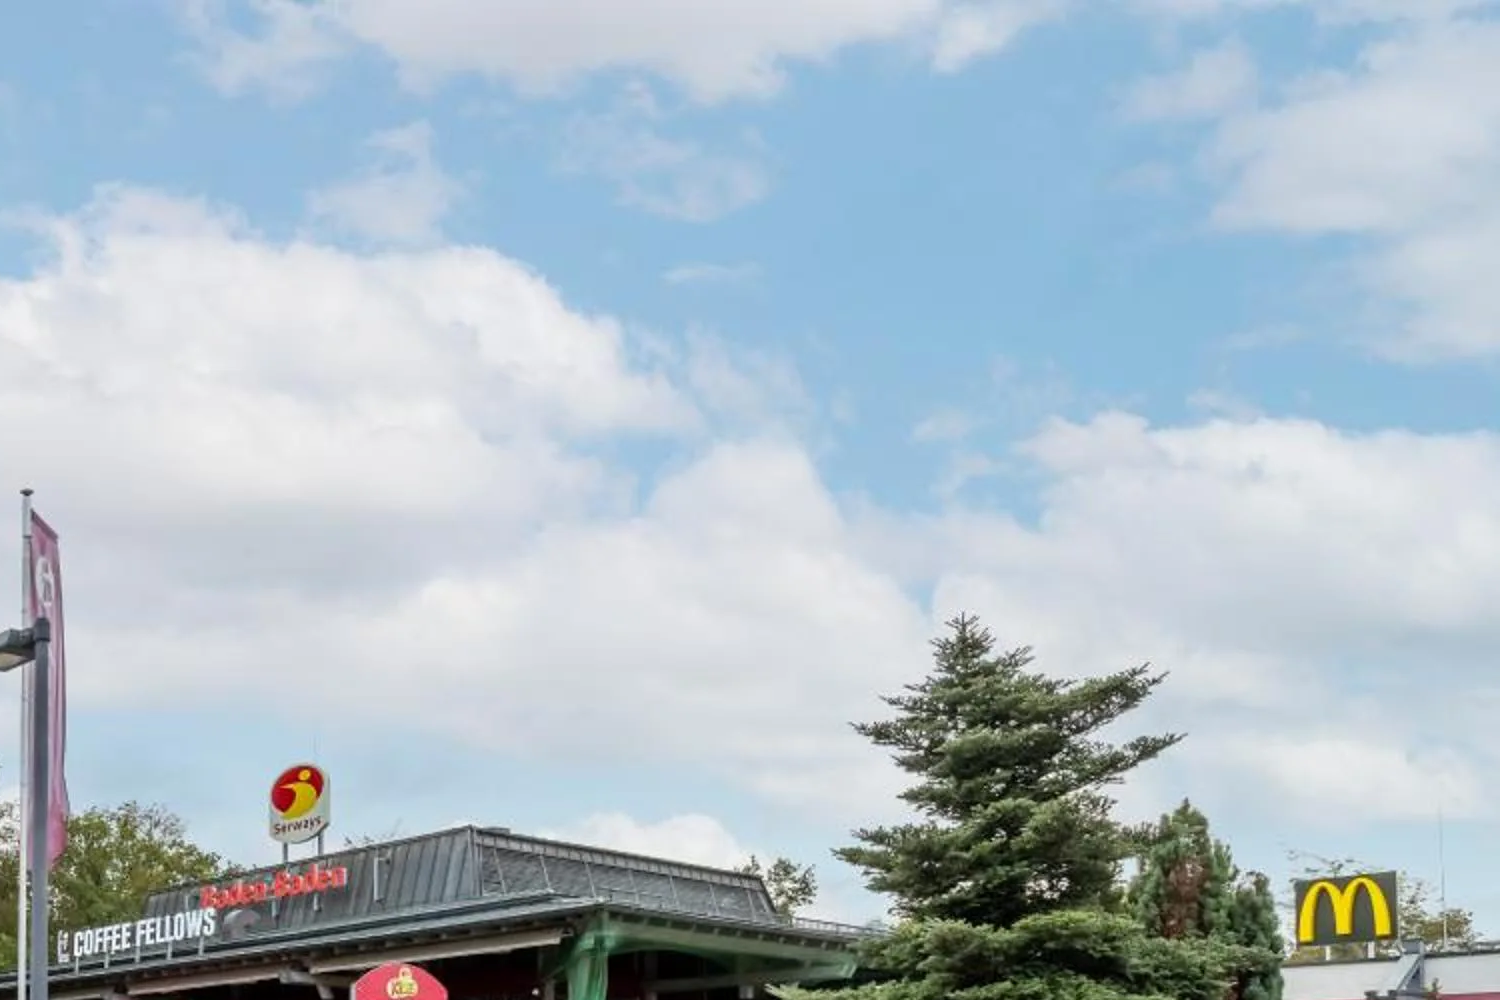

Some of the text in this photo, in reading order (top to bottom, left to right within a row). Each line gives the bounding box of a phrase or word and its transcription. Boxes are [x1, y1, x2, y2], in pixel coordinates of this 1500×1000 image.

[274, 816, 322, 834] Serways
[74, 907, 217, 957] COFFEE FELLOWS
